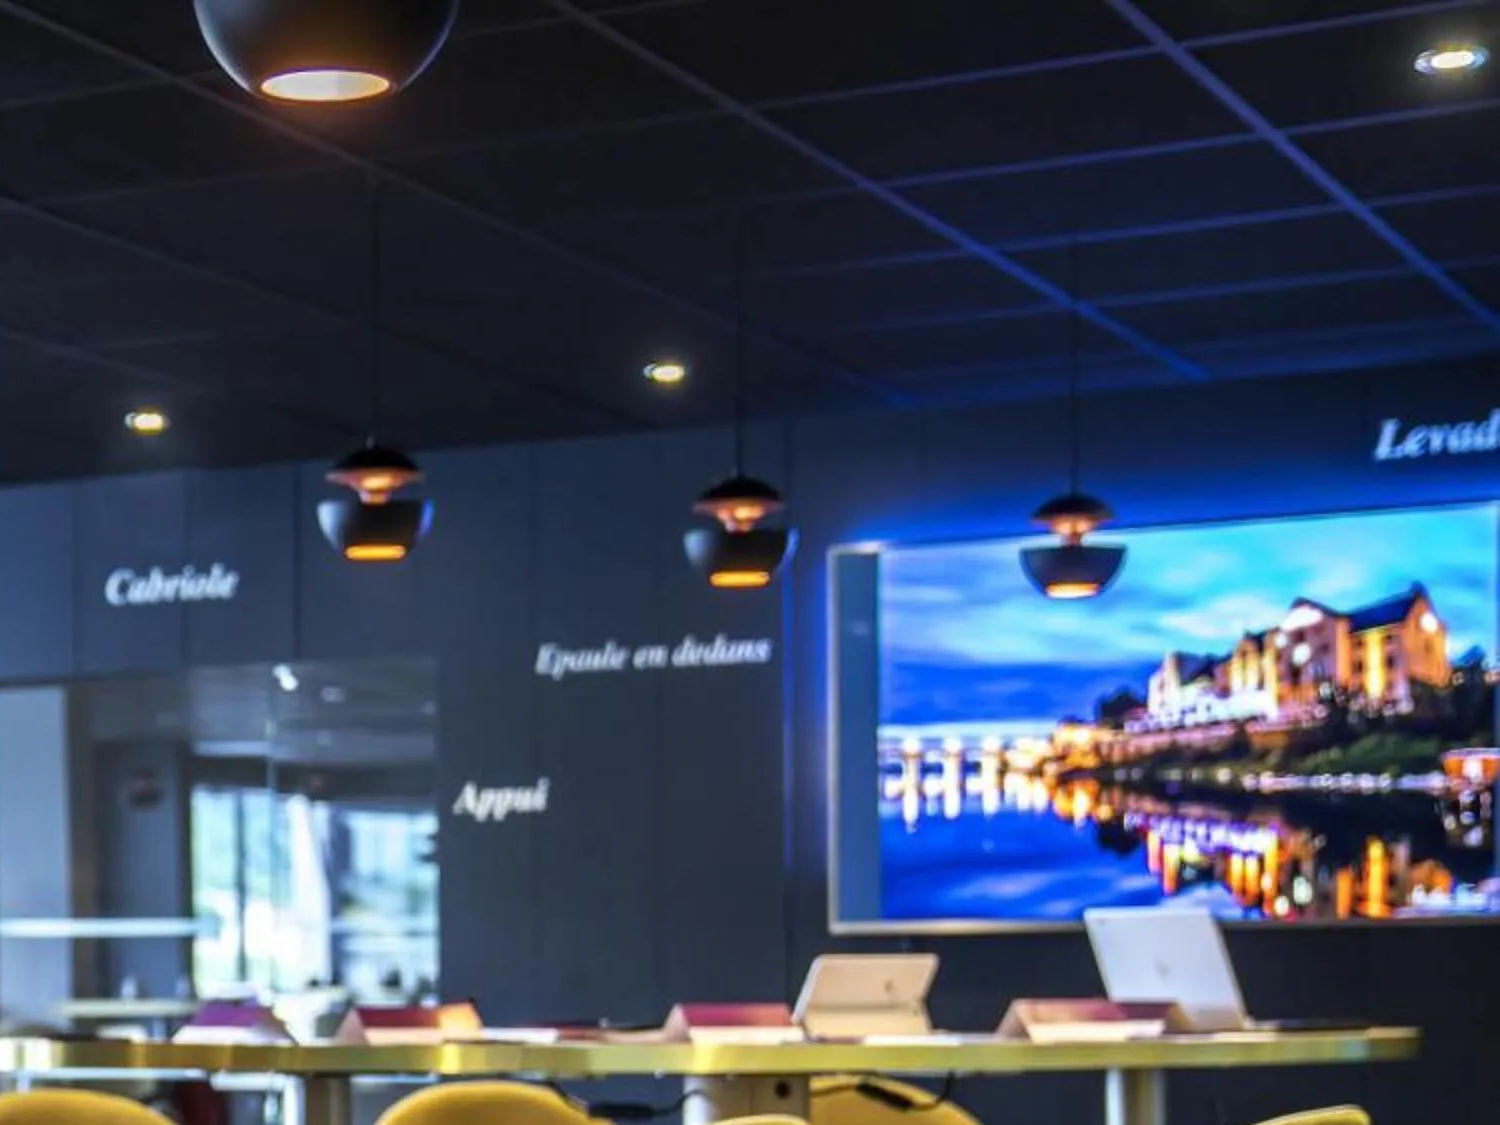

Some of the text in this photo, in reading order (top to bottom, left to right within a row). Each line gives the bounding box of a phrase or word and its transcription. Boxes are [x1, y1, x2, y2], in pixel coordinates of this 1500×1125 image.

[104, 562, 240, 606] Cabriole
[632, 645, 668, 669] en
[671, 634, 772, 668] dedans
[451, 777, 550, 821] Appui
